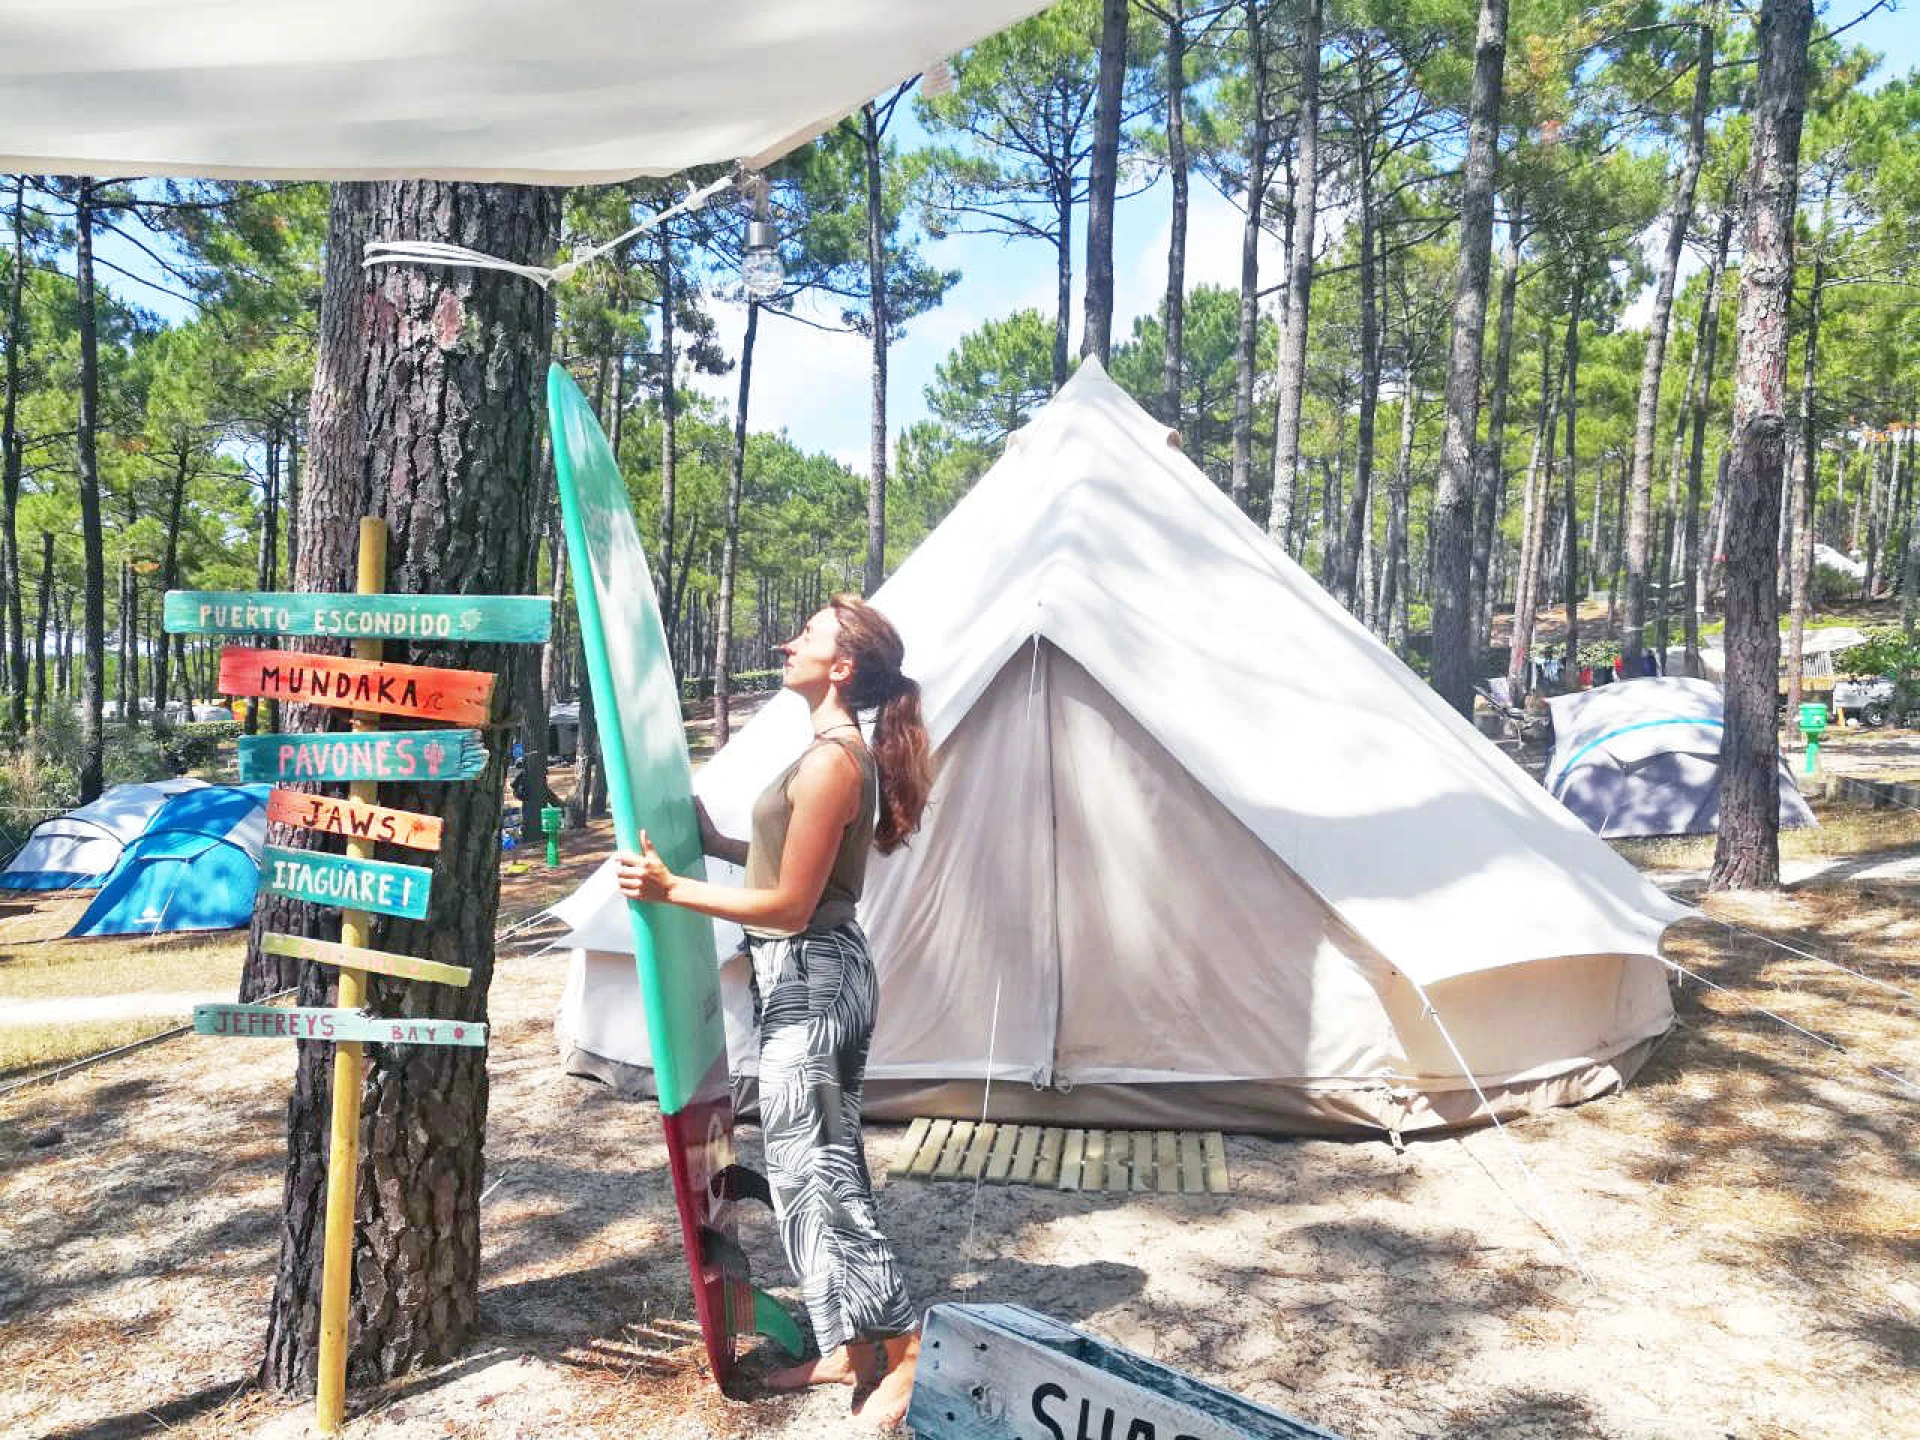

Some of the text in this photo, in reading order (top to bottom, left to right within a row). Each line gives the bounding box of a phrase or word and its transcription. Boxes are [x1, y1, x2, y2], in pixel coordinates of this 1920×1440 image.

[199, 604, 289, 631] PUERTO
[260, 665, 418, 708] MUNDAKA
[277, 738, 417, 777] PAVONES
[302, 800, 397, 842] JAWS
[213, 1010, 437, 1042] JEFFREYS BAY
[1031, 1382, 1200, 1440] SH
